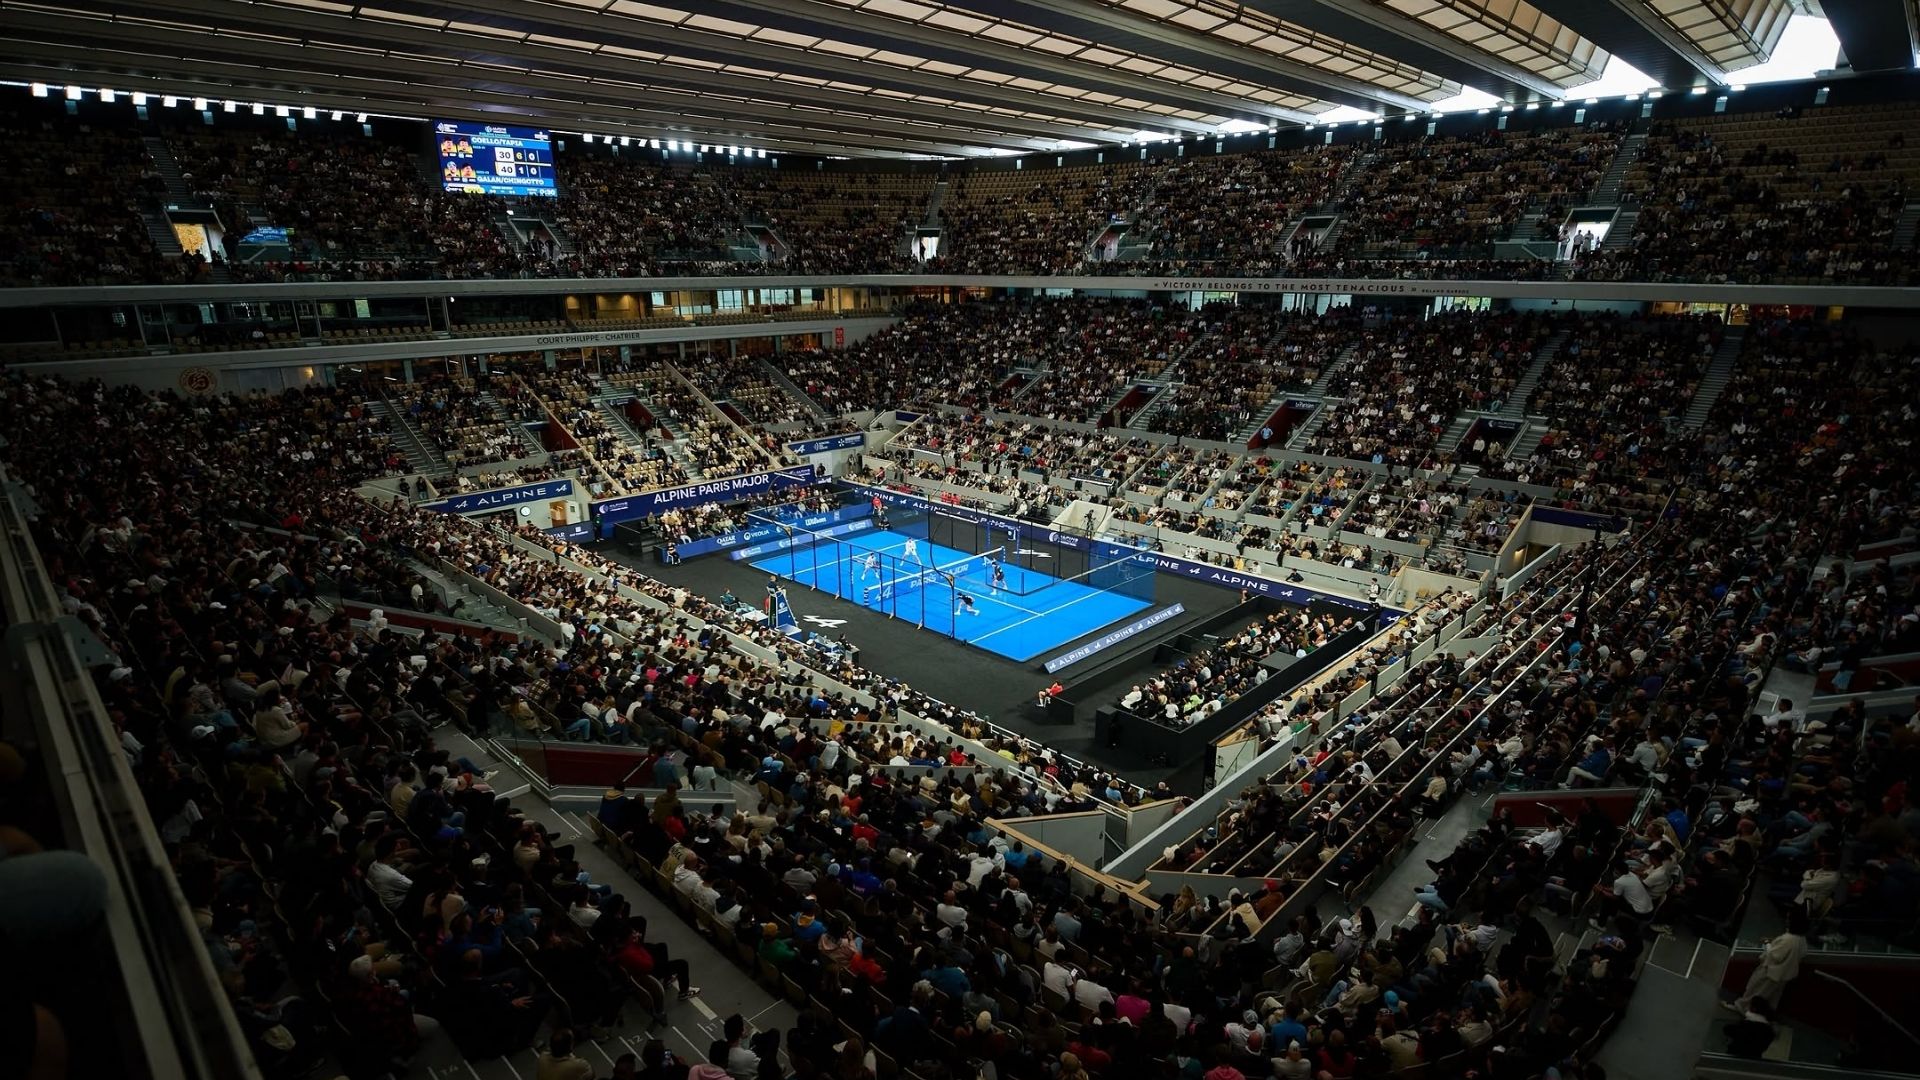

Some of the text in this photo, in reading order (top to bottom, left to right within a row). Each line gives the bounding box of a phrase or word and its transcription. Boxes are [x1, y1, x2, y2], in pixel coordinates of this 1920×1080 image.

[471, 136, 523, 147] COELLO/TAPIA
[499, 151, 535, 161] 30 6 0
[500, 166, 537, 175] 40 1 0
[1162, 281, 1204, 289] VICTORY
[1207, 282, 1253, 290] BELONGS
[1275, 283, 1295, 291] THE
[1336, 284, 1405, 292] TENACIOUS
[536, 337, 564, 345] COURT
[566, 334, 600, 343] PHILIPPE
[605, 332, 640, 340] CHATRIER
[654, 474, 769, 504] ALPINE PARIS MAJOR
[477, 487, 547, 506] ALPINE
[1211, 573, 1269, 592] ALPINE
[1147, 610, 1174, 626] ALPINE
[1105, 627, 1134, 644] ALPINE
[1059, 647, 1090, 666] ALPINE
[628, 1034, 643, 1045] 12
